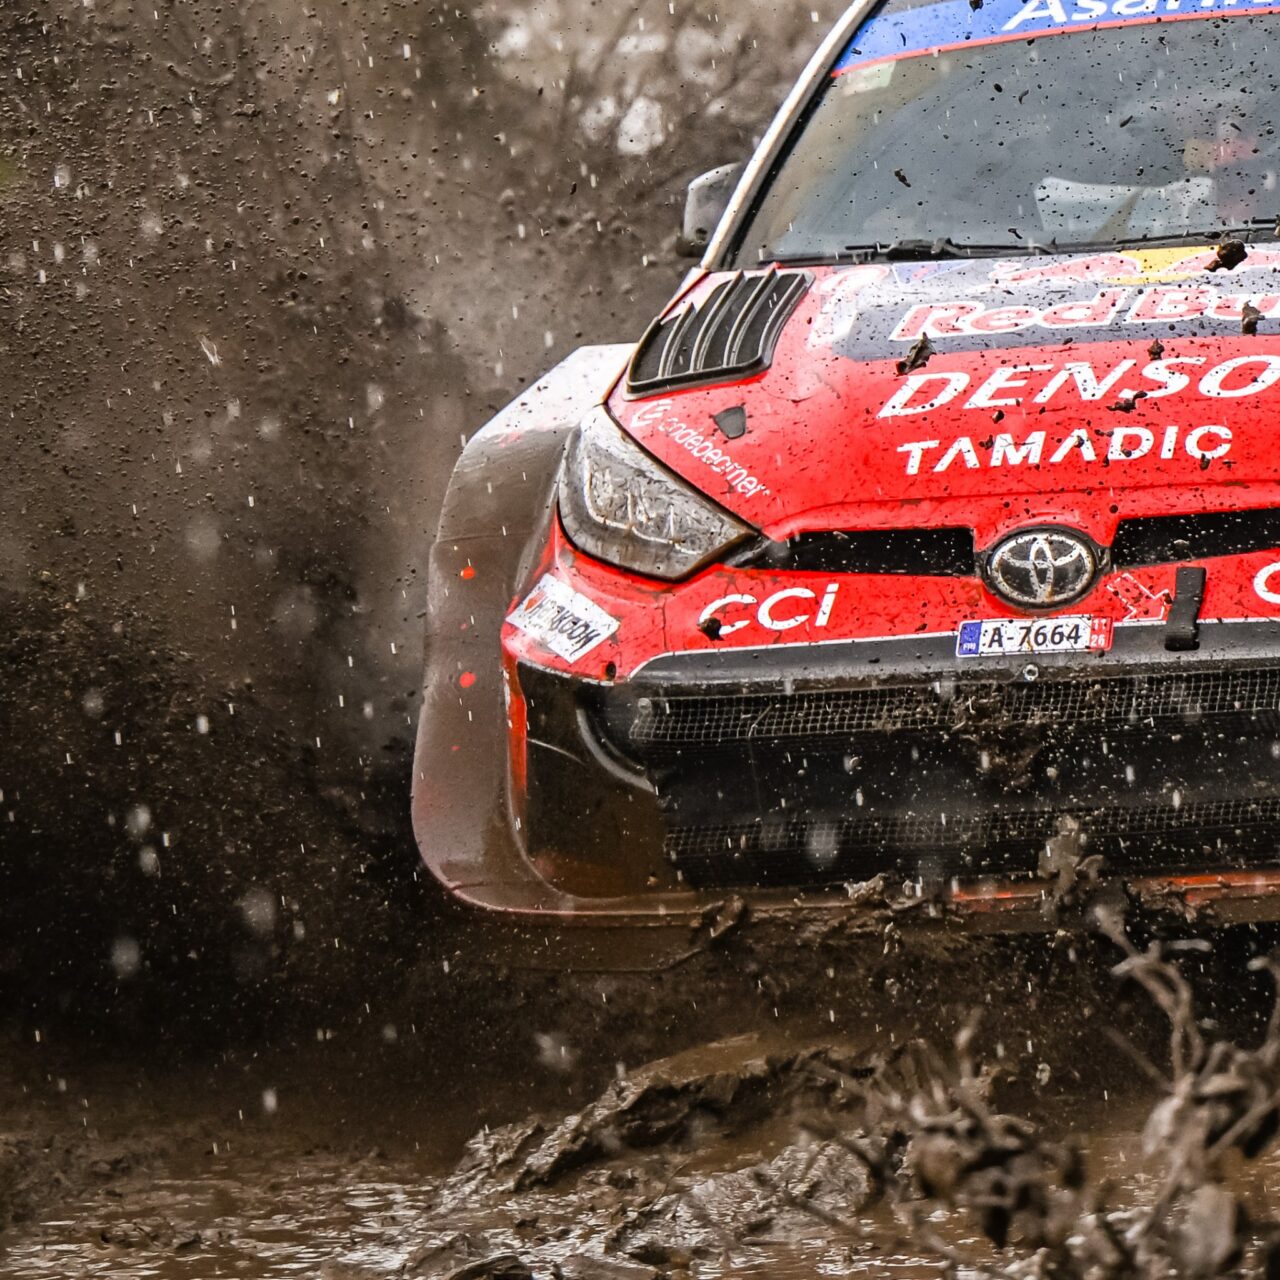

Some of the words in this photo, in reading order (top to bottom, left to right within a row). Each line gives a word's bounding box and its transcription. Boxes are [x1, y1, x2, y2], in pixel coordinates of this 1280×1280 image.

[889, 288, 1126, 341] Red
[897, 425, 1233, 475] TAMADIC
[987, 623, 1082, 649] A-7664
